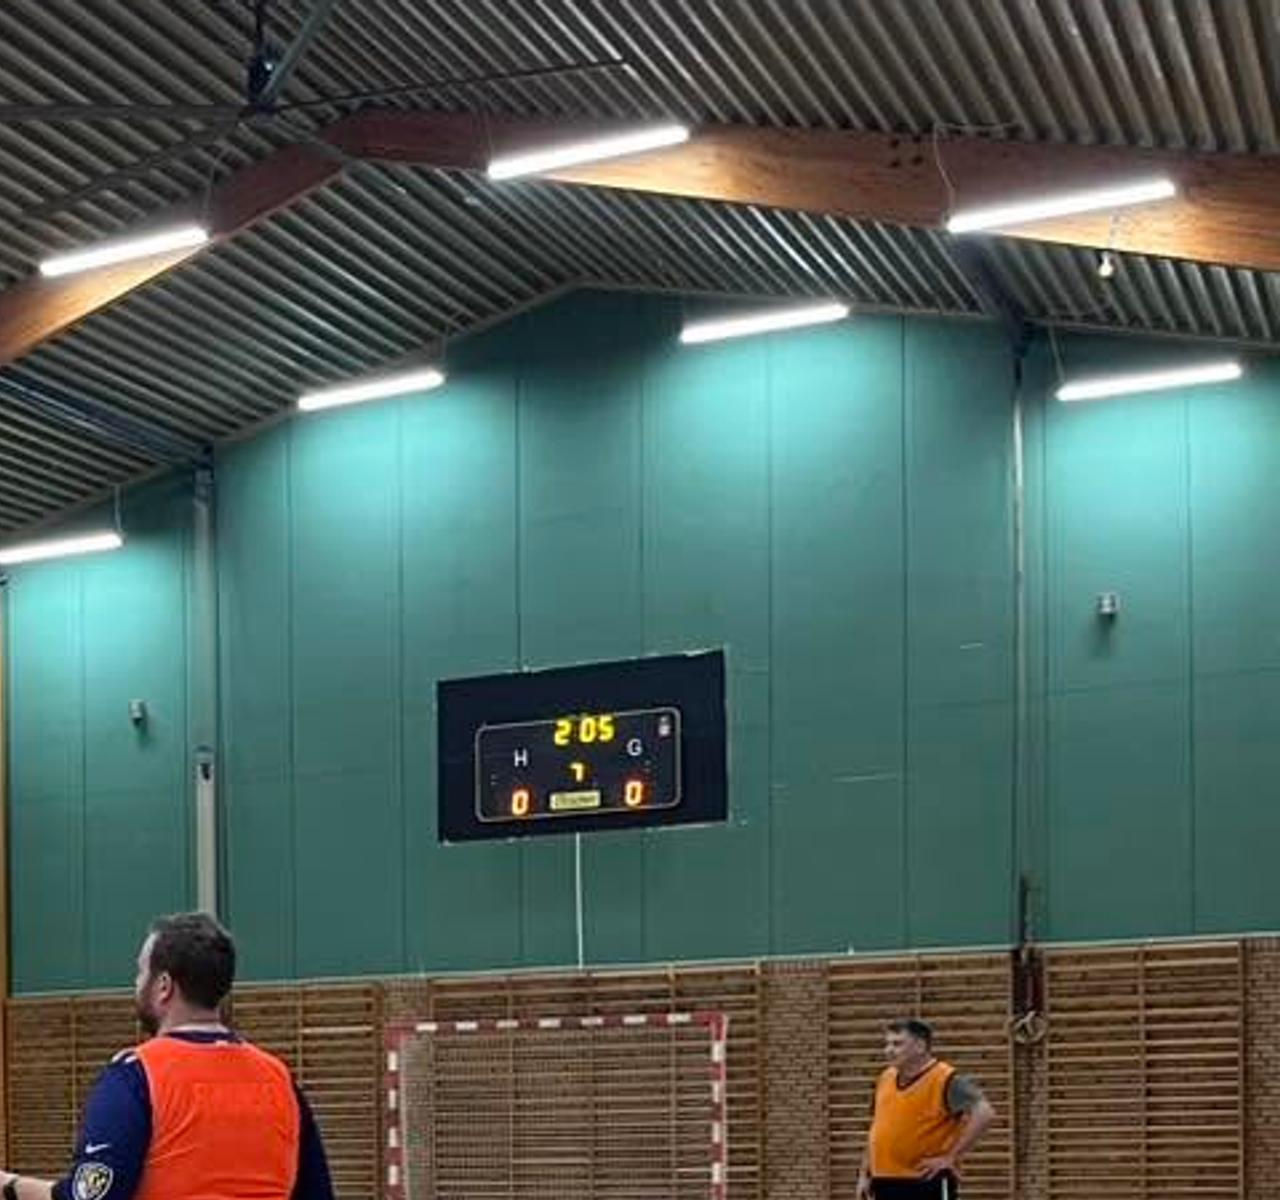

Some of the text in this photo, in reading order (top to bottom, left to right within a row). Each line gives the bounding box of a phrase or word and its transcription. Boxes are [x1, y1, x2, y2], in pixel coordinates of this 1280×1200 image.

[513, 748, 528, 768] H
[626, 738, 642, 757] G
[511, 789, 529, 815] 0
[625, 780, 643, 807] 0
